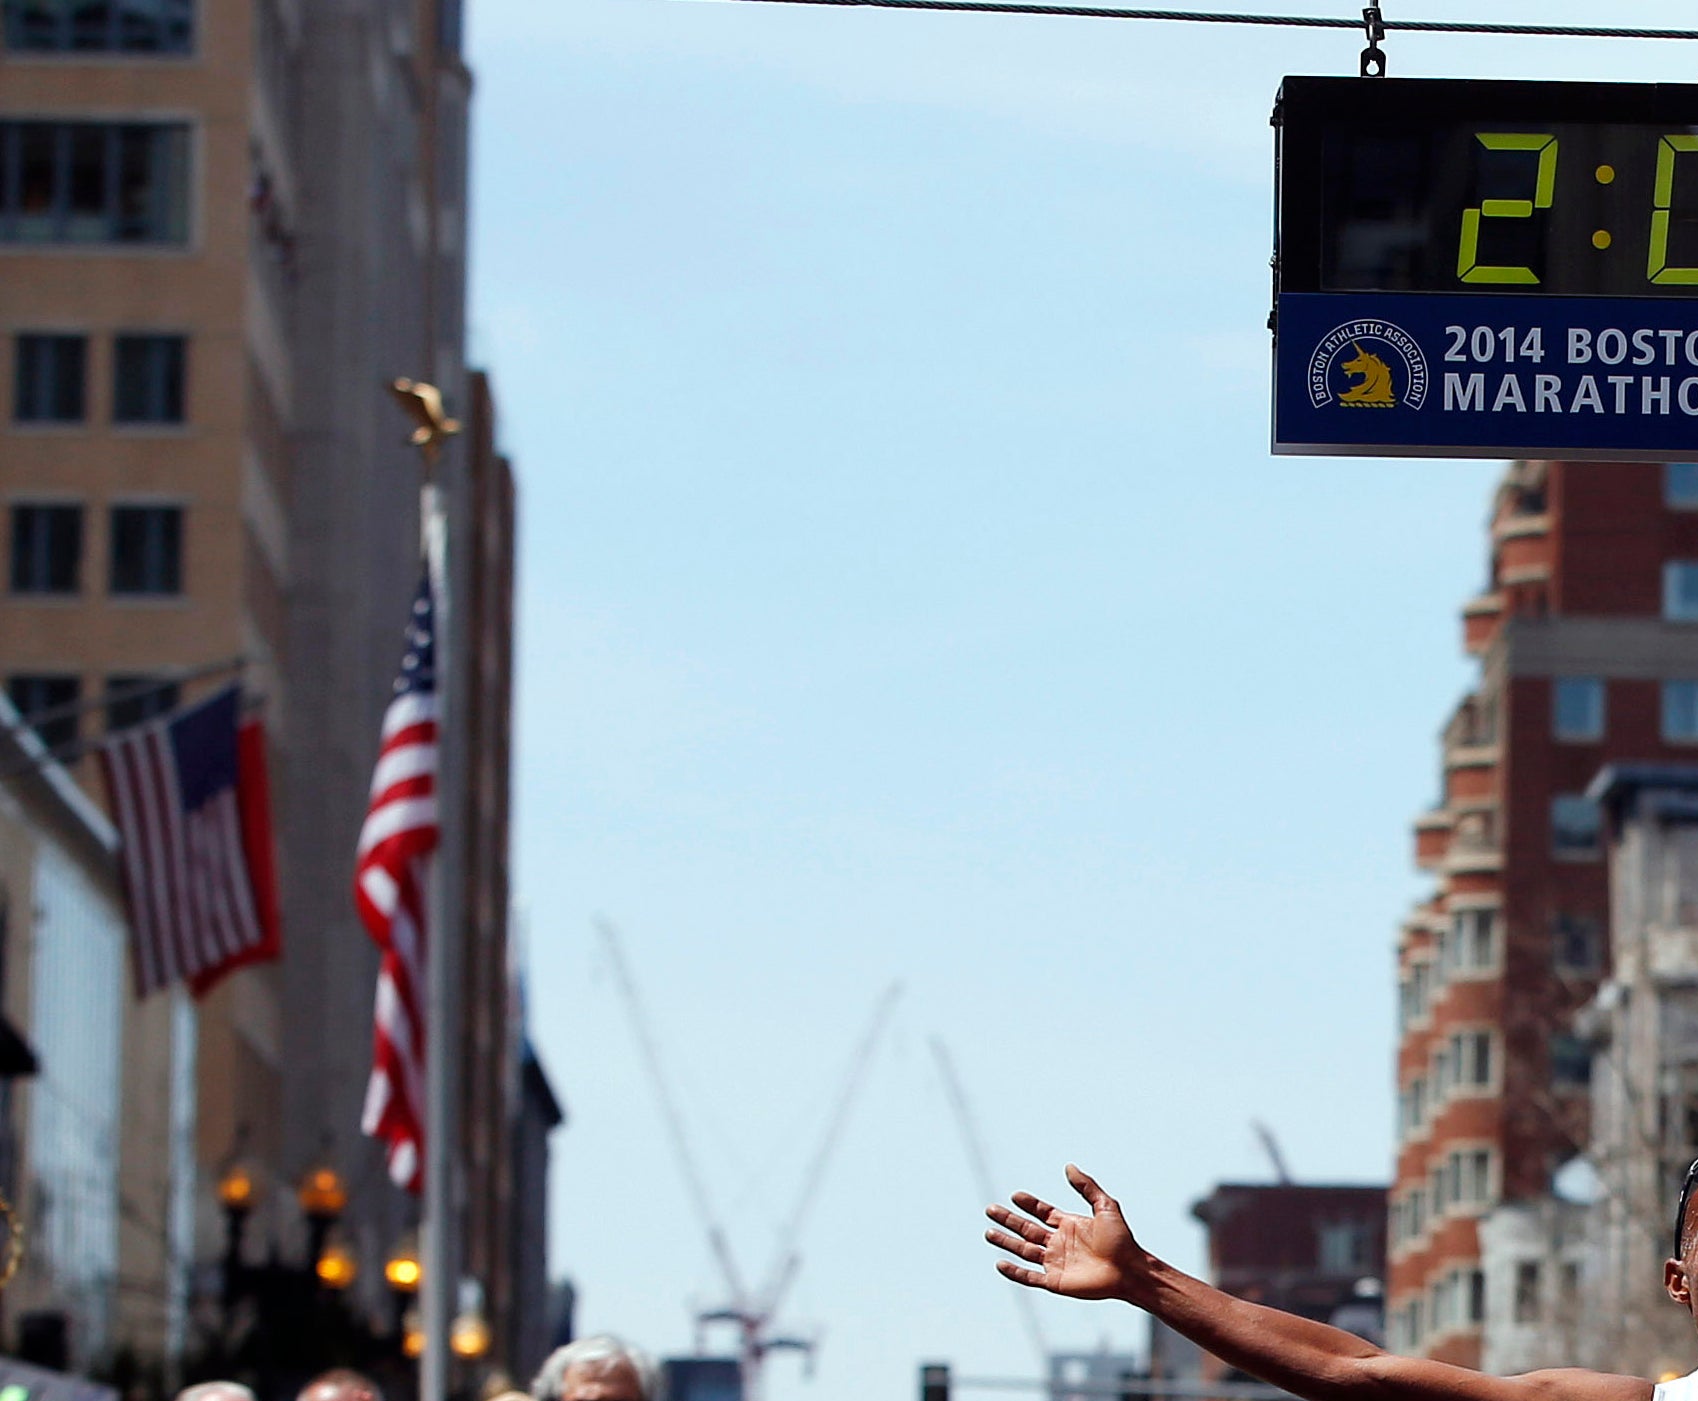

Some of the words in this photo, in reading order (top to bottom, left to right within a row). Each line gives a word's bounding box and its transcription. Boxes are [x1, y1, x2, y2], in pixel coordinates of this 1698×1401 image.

[1313, 351, 1330, 400] BOSTON
[1325, 323, 1383, 352] ATHLETIC
[1384, 328, 1424, 402] ASSOCIATION
[1444, 325, 1545, 363] 2014
